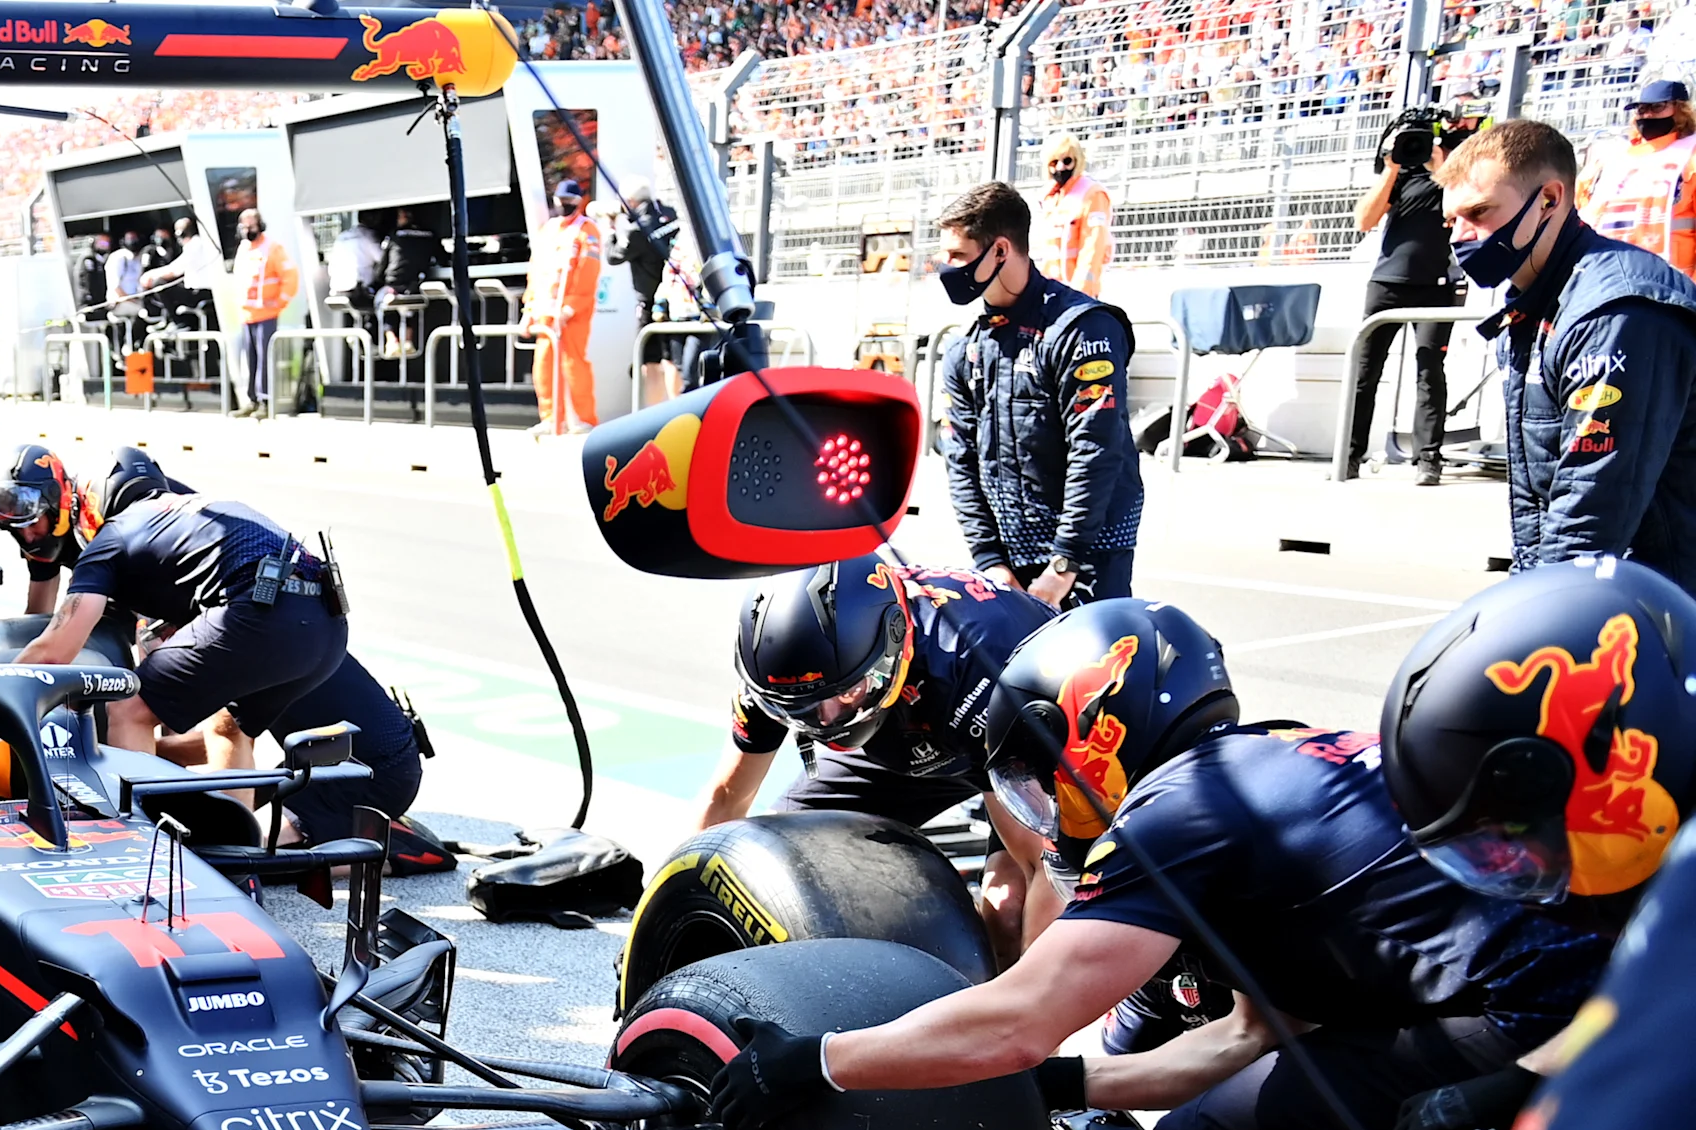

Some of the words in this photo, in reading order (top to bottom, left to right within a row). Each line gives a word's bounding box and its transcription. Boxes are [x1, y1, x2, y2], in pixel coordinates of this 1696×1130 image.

[15, 19, 58, 43] Bull
[95, 674, 127, 694] Tezos
[44, 746, 76, 758] NTER
[61, 912, 286, 968] 11
[188, 991, 265, 1013] JUMBO
[177, 1034, 309, 1058] ORACLE
[228, 1066, 330, 1088] Tezos
